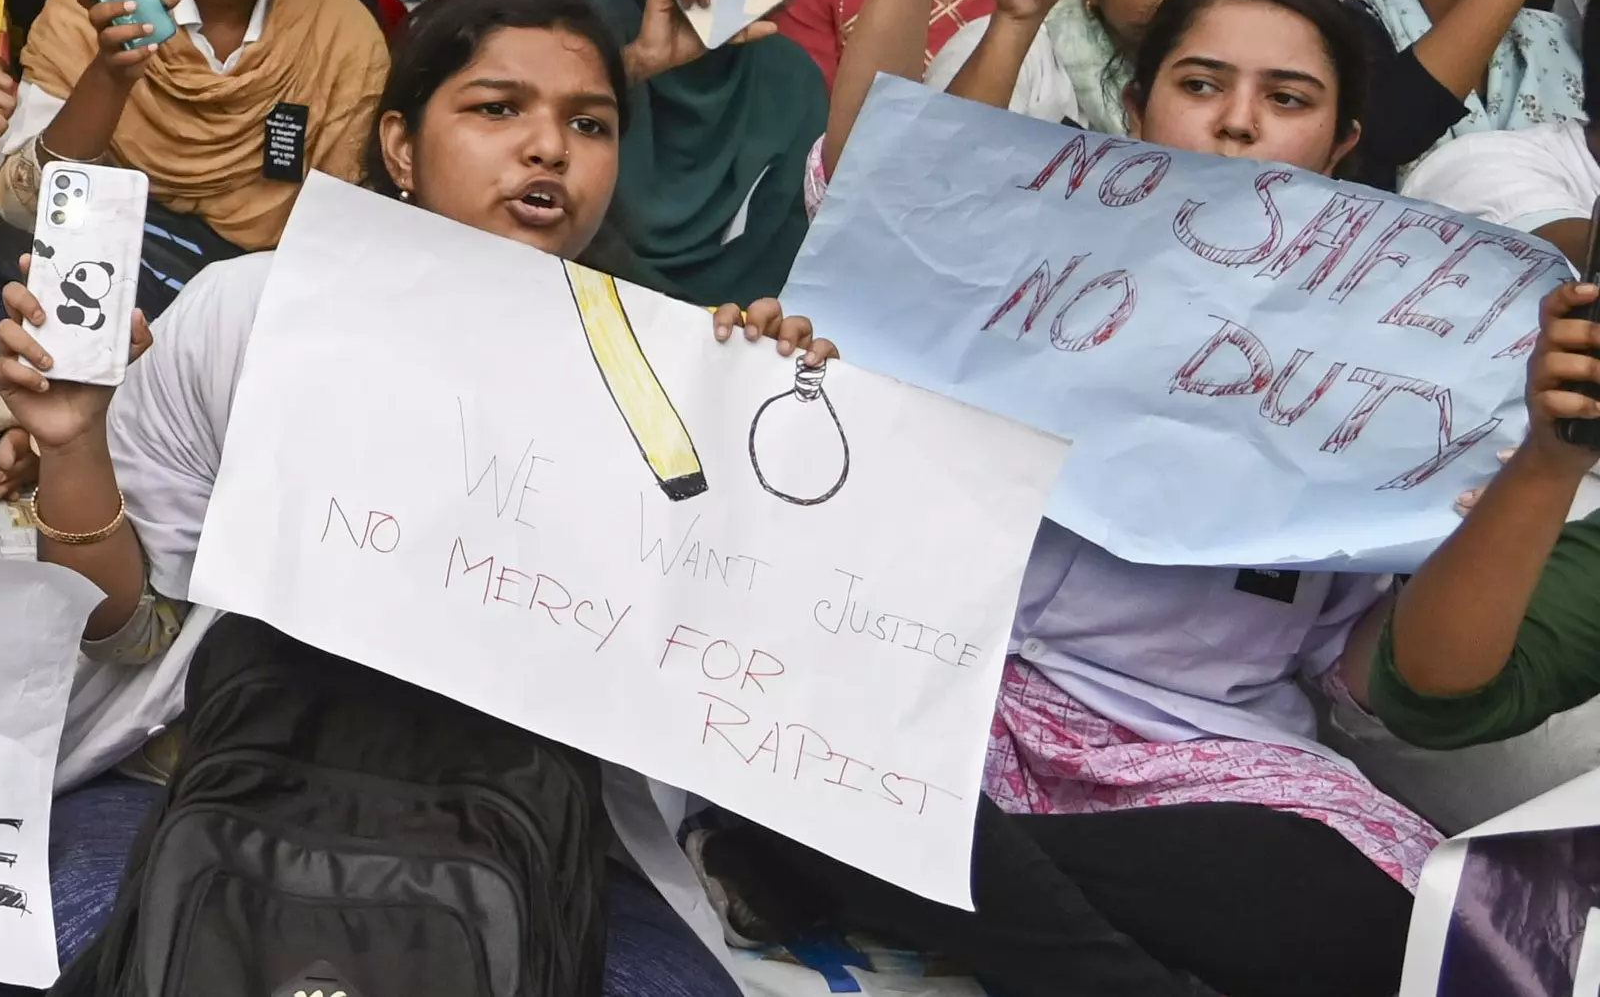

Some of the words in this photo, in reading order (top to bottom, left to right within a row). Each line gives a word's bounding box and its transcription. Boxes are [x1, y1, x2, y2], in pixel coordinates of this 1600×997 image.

[1016, 133, 1172, 208] NO
[981, 252, 1139, 352] NO
[1169, 314, 1504, 491] DUTY
[320, 497, 400, 553] NO
[445, 536, 632, 652] MERCY
[659, 623, 785, 693] FOR
[457, 396, 555, 530] WE
[638, 491, 773, 591] WANT
[813, 568, 983, 669] JUSTICE
[698, 690, 963, 815] RAPIST
